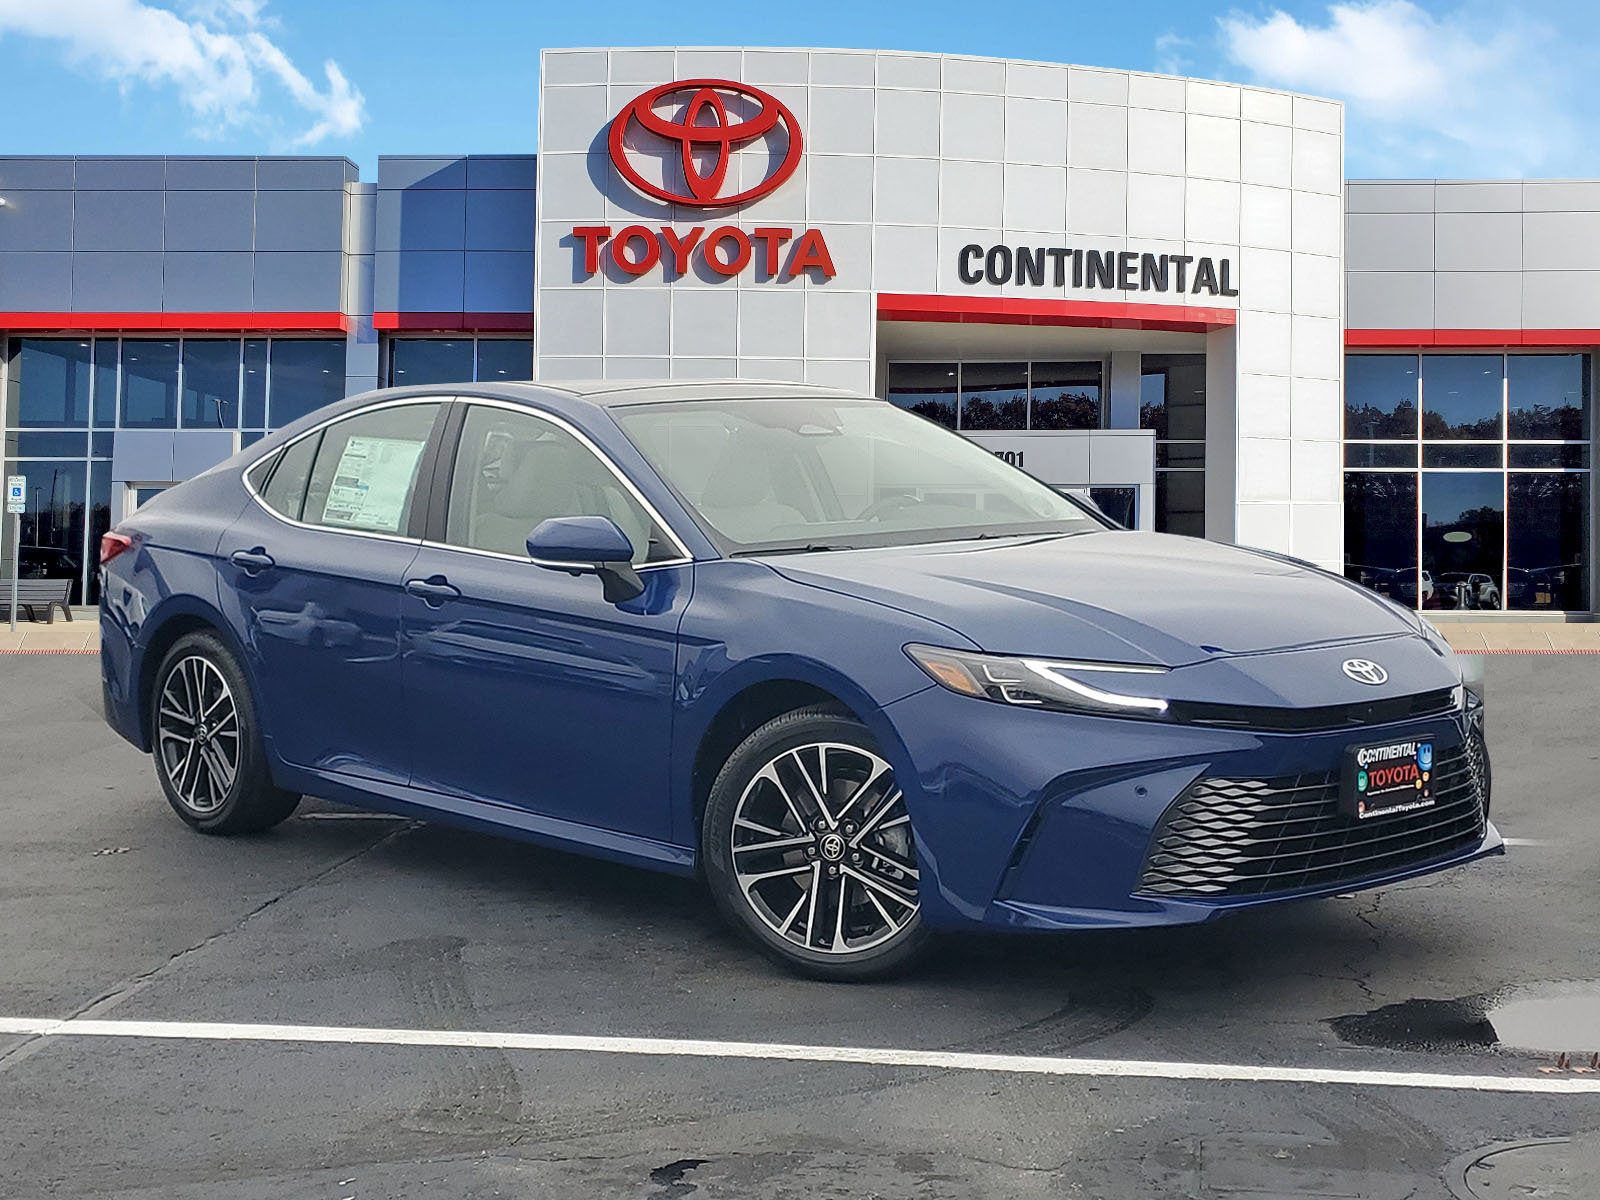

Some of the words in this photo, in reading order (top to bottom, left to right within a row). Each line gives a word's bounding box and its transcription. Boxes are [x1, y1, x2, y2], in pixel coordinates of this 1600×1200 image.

[572, 225, 837, 277] TOYOTA
[958, 244, 1239, 297] CONTINENTAL
[1357, 742, 1417, 766] CONTINENTAL
[1368, 764, 1420, 787] TOYOTA
[1359, 800, 1435, 819] ContinentalToyota.com
